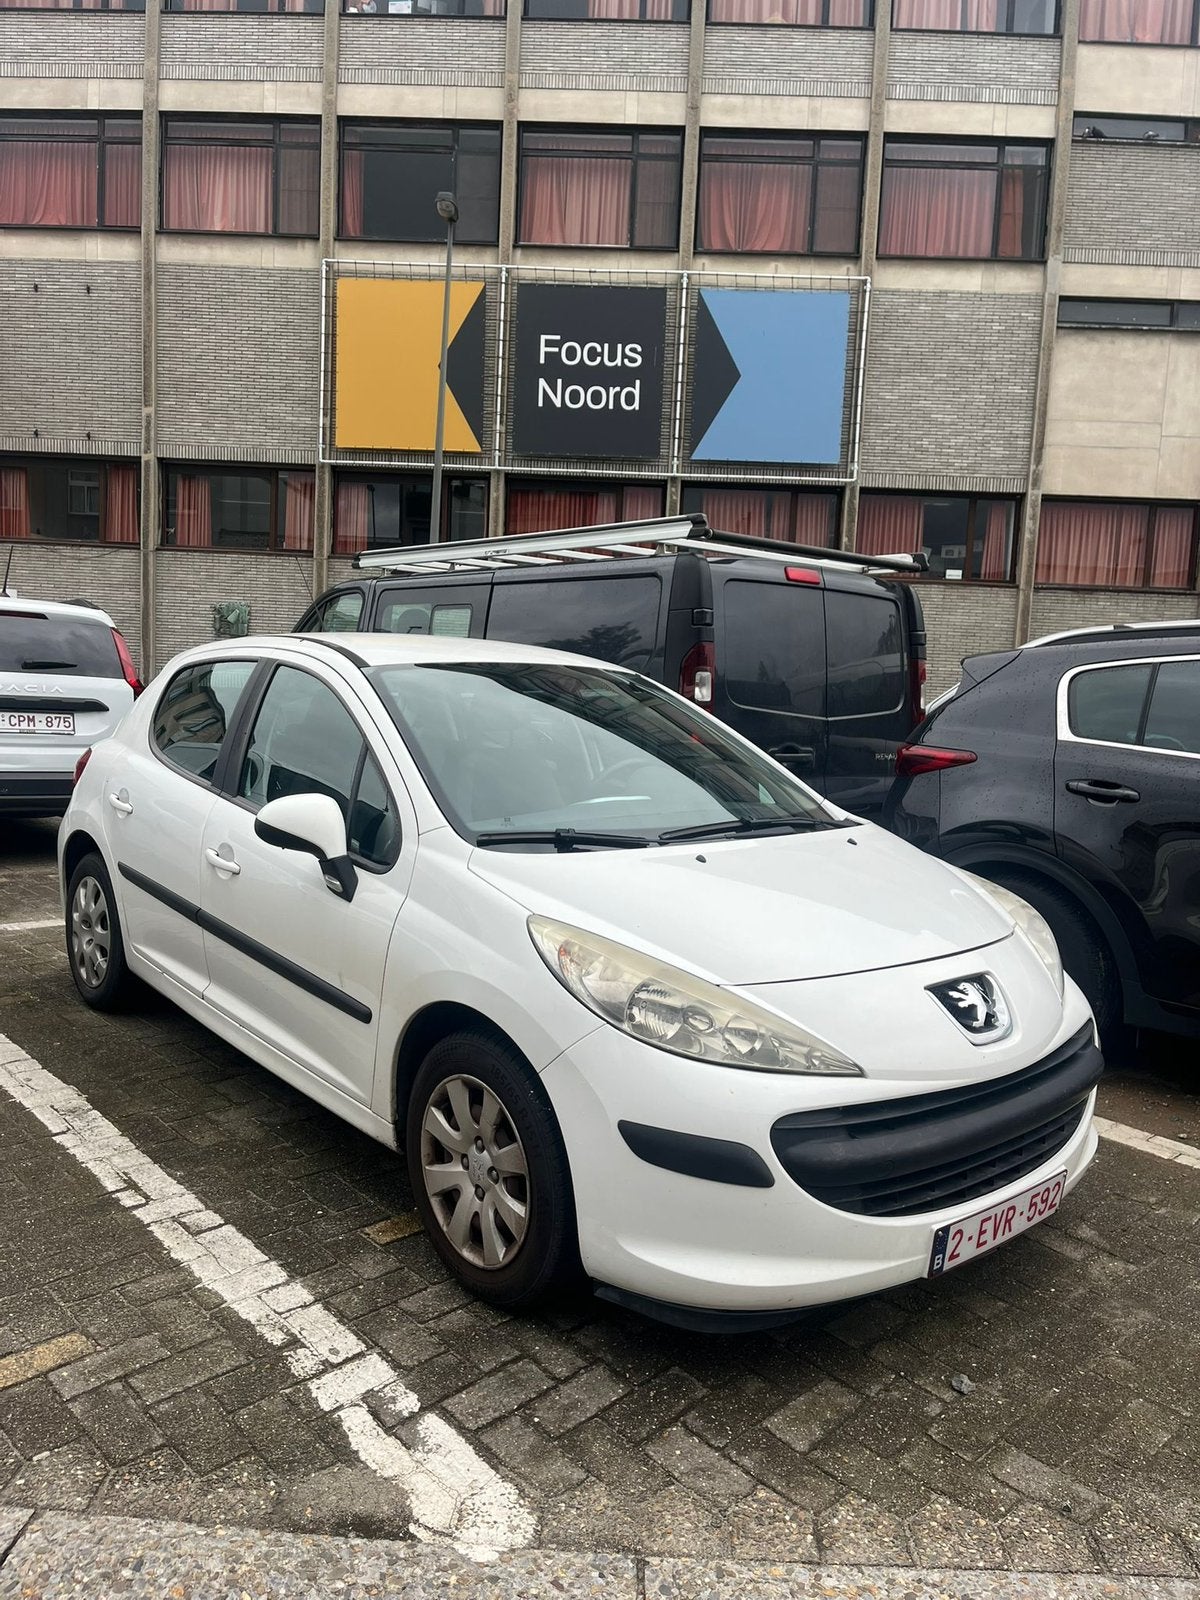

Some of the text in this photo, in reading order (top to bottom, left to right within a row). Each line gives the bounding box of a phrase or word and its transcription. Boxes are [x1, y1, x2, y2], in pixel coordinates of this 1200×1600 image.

[539, 334, 643, 368] Focus
[537, 377, 641, 411] Noord
[0, 683, 64, 694] ACIA
[947, 1181, 1062, 1262] 2-EVR-592
[933, 1254, 943, 1270] B
